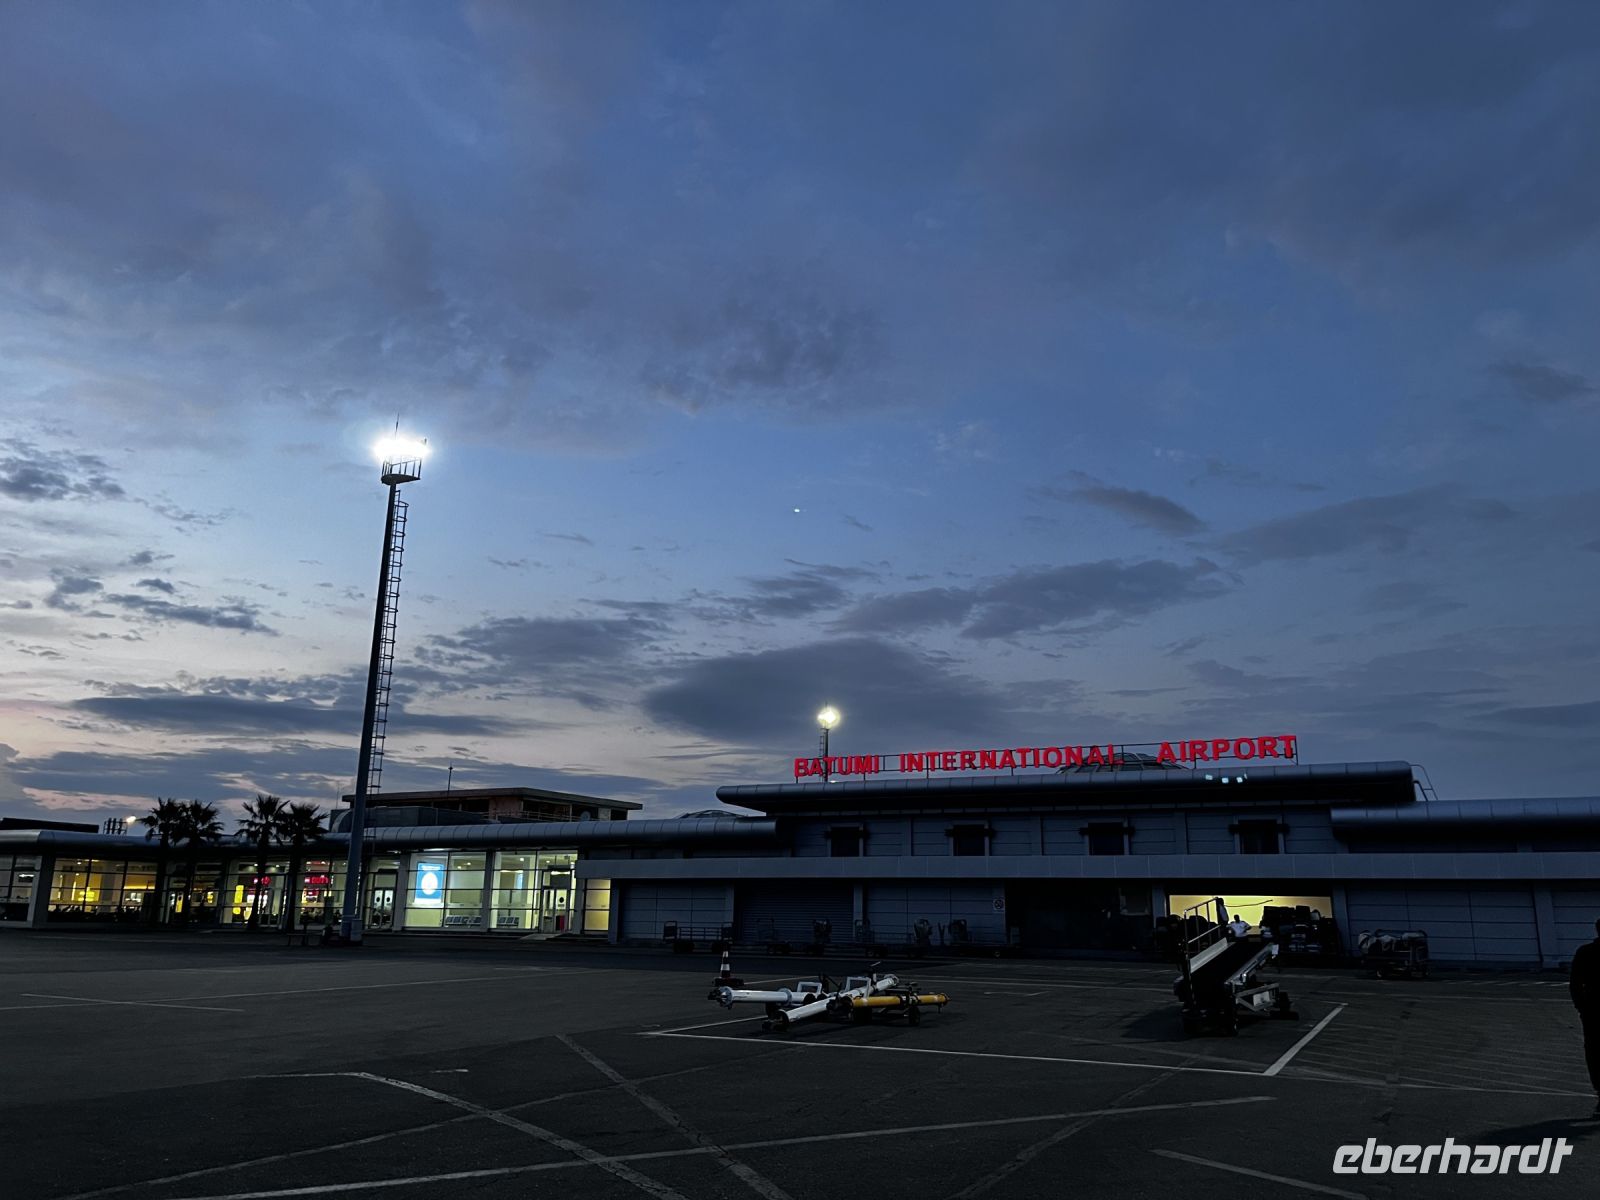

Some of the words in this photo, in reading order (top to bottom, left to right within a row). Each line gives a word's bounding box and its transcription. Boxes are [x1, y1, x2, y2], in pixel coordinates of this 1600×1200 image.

[794, 754, 880, 777] BATUMI
[899, 743, 1125, 772] INTERNATIONAL
[1156, 735, 1297, 763] AIRPORT
